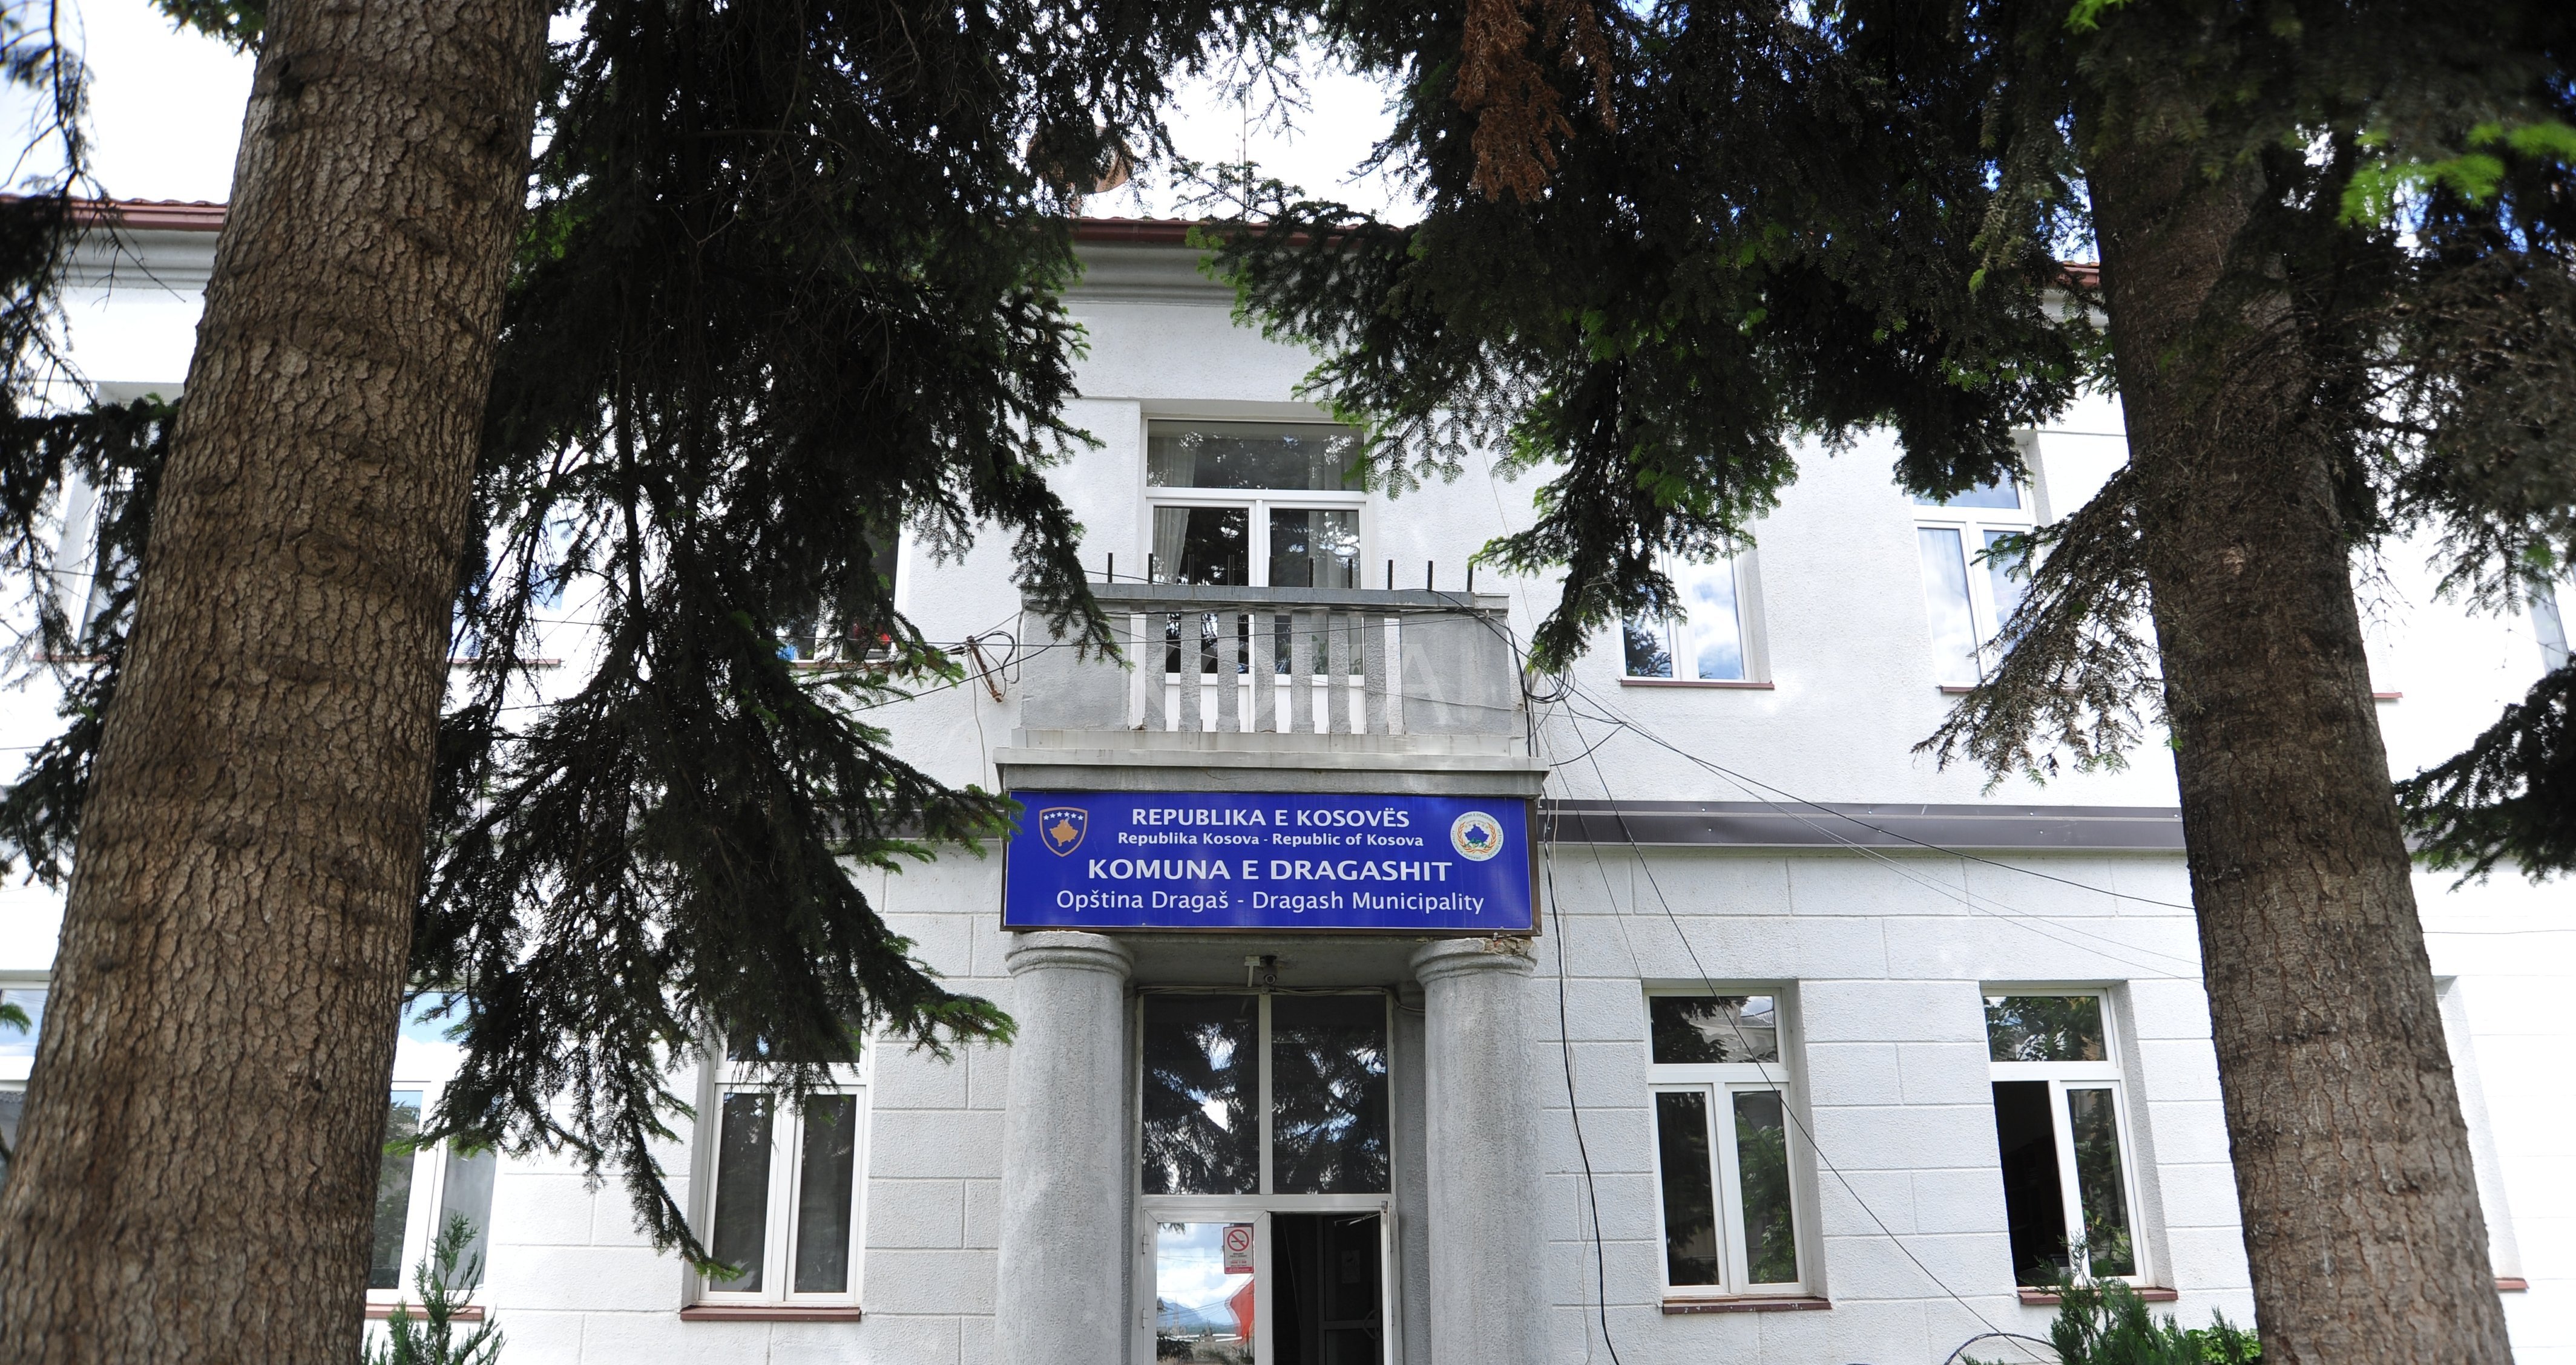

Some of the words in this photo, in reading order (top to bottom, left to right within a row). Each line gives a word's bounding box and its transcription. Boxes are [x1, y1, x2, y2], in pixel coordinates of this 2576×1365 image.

[1132, 808, 1267, 826] REPUBLIKA
[1275, 810, 1289, 826] E
[1297, 807, 1410, 828] KOSOVËS
[1118, 831, 1198, 846] Republika
[1203, 833, 1260, 845] Kosova
[1272, 833, 1341, 848] Republic
[1345, 833, 1362, 845] of
[1367, 834, 1424, 846] Kosova
[1088, 859, 1231, 880] KOMUNA
[1243, 860, 1259, 880] E
[1270, 860, 1453, 882] DRAGASHIT
[1057, 889, 1144, 912] Opština
[1152, 890, 1229, 913] Dragaš
[1253, 891, 1343, 913] Dragash
[1353, 892, 1484, 915] Municipality
